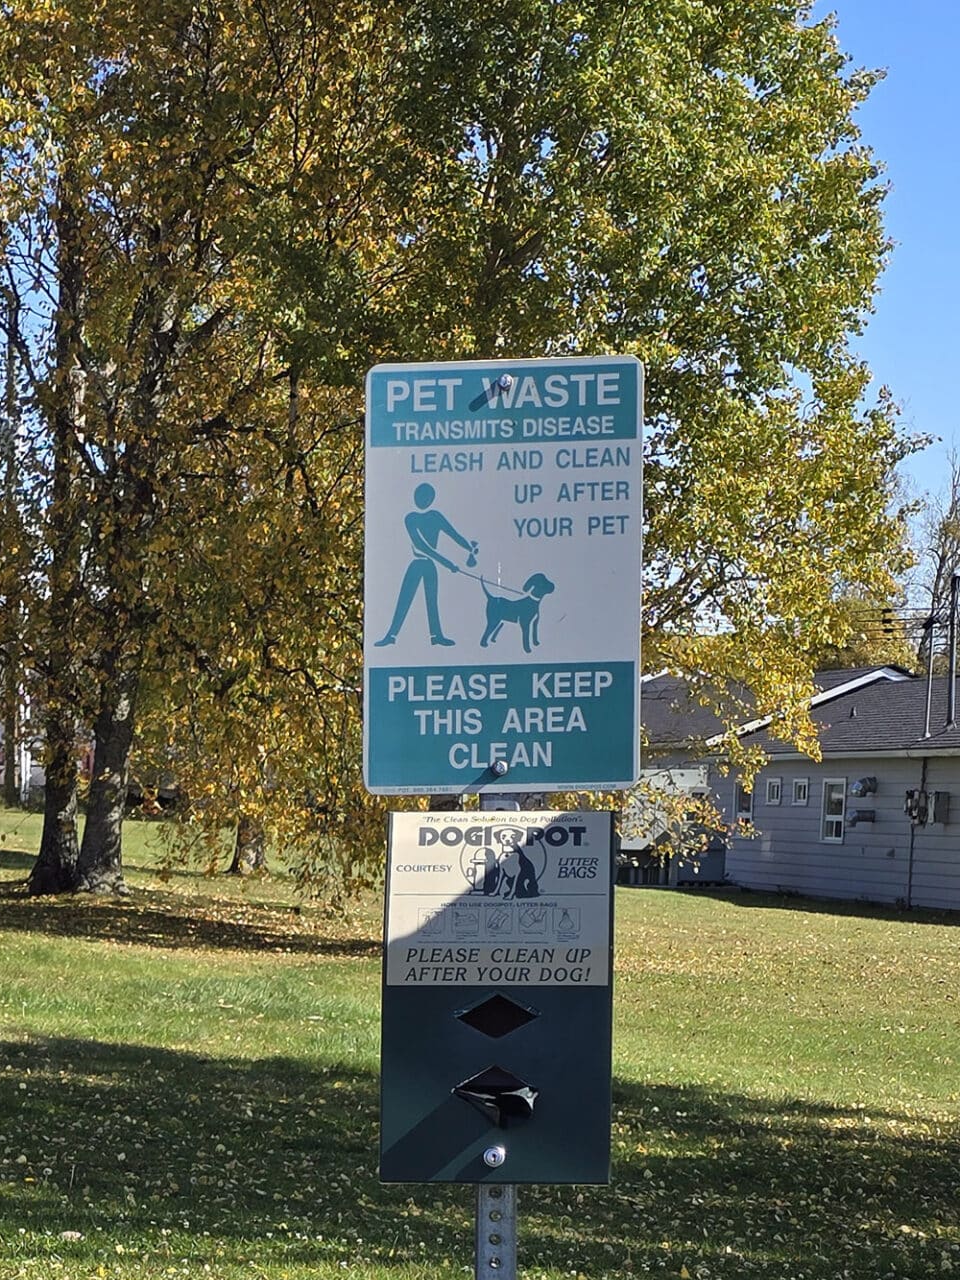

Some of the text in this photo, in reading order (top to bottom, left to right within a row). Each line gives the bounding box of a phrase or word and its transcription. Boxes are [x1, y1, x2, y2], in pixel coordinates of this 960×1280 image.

[386, 372, 621, 413] PET WASTE
[392, 416, 614, 441] TRANSMITS DISEASE
[411, 447, 631, 474] LEASH AND CLEAN
[514, 481, 630, 504] UP AFTER
[513, 515, 630, 538] YOUR PET
[388, 671, 614, 702] PLEASE KEEP
[413, 706, 587, 735] THIS AREA
[448, 741, 552, 769] CLEAN
[443, 815, 469, 823] Clean
[471, 815, 507, 823] Solution
[508, 815, 518, 823] to
[519, 815, 538, 825] Dog
[396, 863, 453, 873] COURTESY
[557, 857, 599, 867] LITTER
[557, 867, 598, 879] BAGS
[405, 947, 592, 963] PLEASE CLEAN UP
[404, 966, 592, 982] AFTER YOUR DOG!
